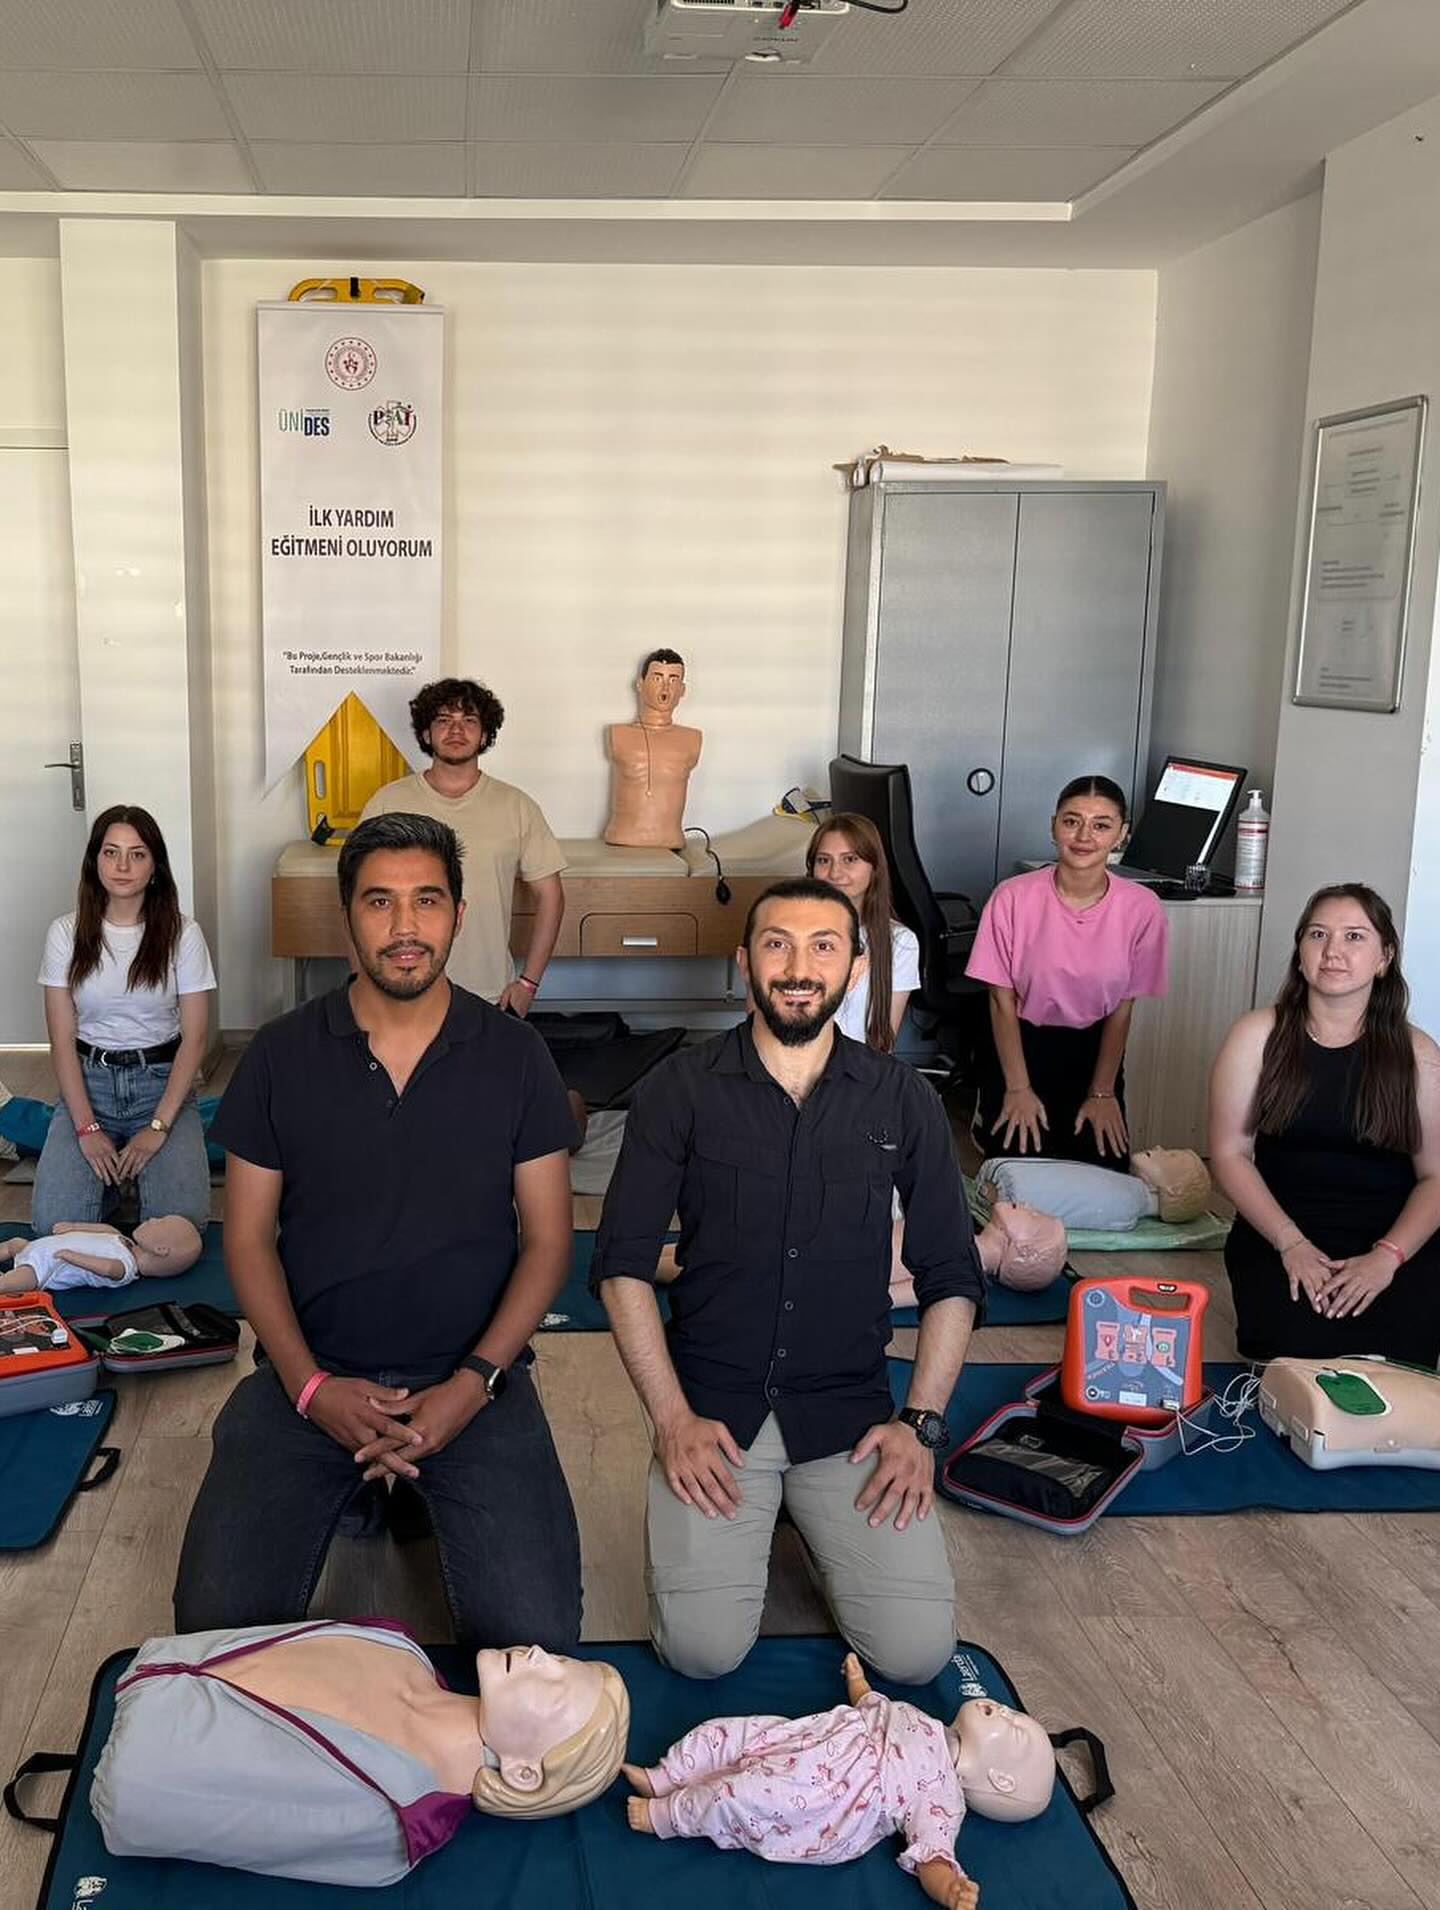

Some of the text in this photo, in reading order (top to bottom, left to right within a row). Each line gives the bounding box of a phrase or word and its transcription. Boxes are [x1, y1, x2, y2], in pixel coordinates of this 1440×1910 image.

[304, 416, 330, 436] DES
[309, 505, 394, 528] İLK YARDIM
[271, 534, 432, 557] EĞİTMENİ OLUYORUM
[364, 652, 383, 663] Spor
